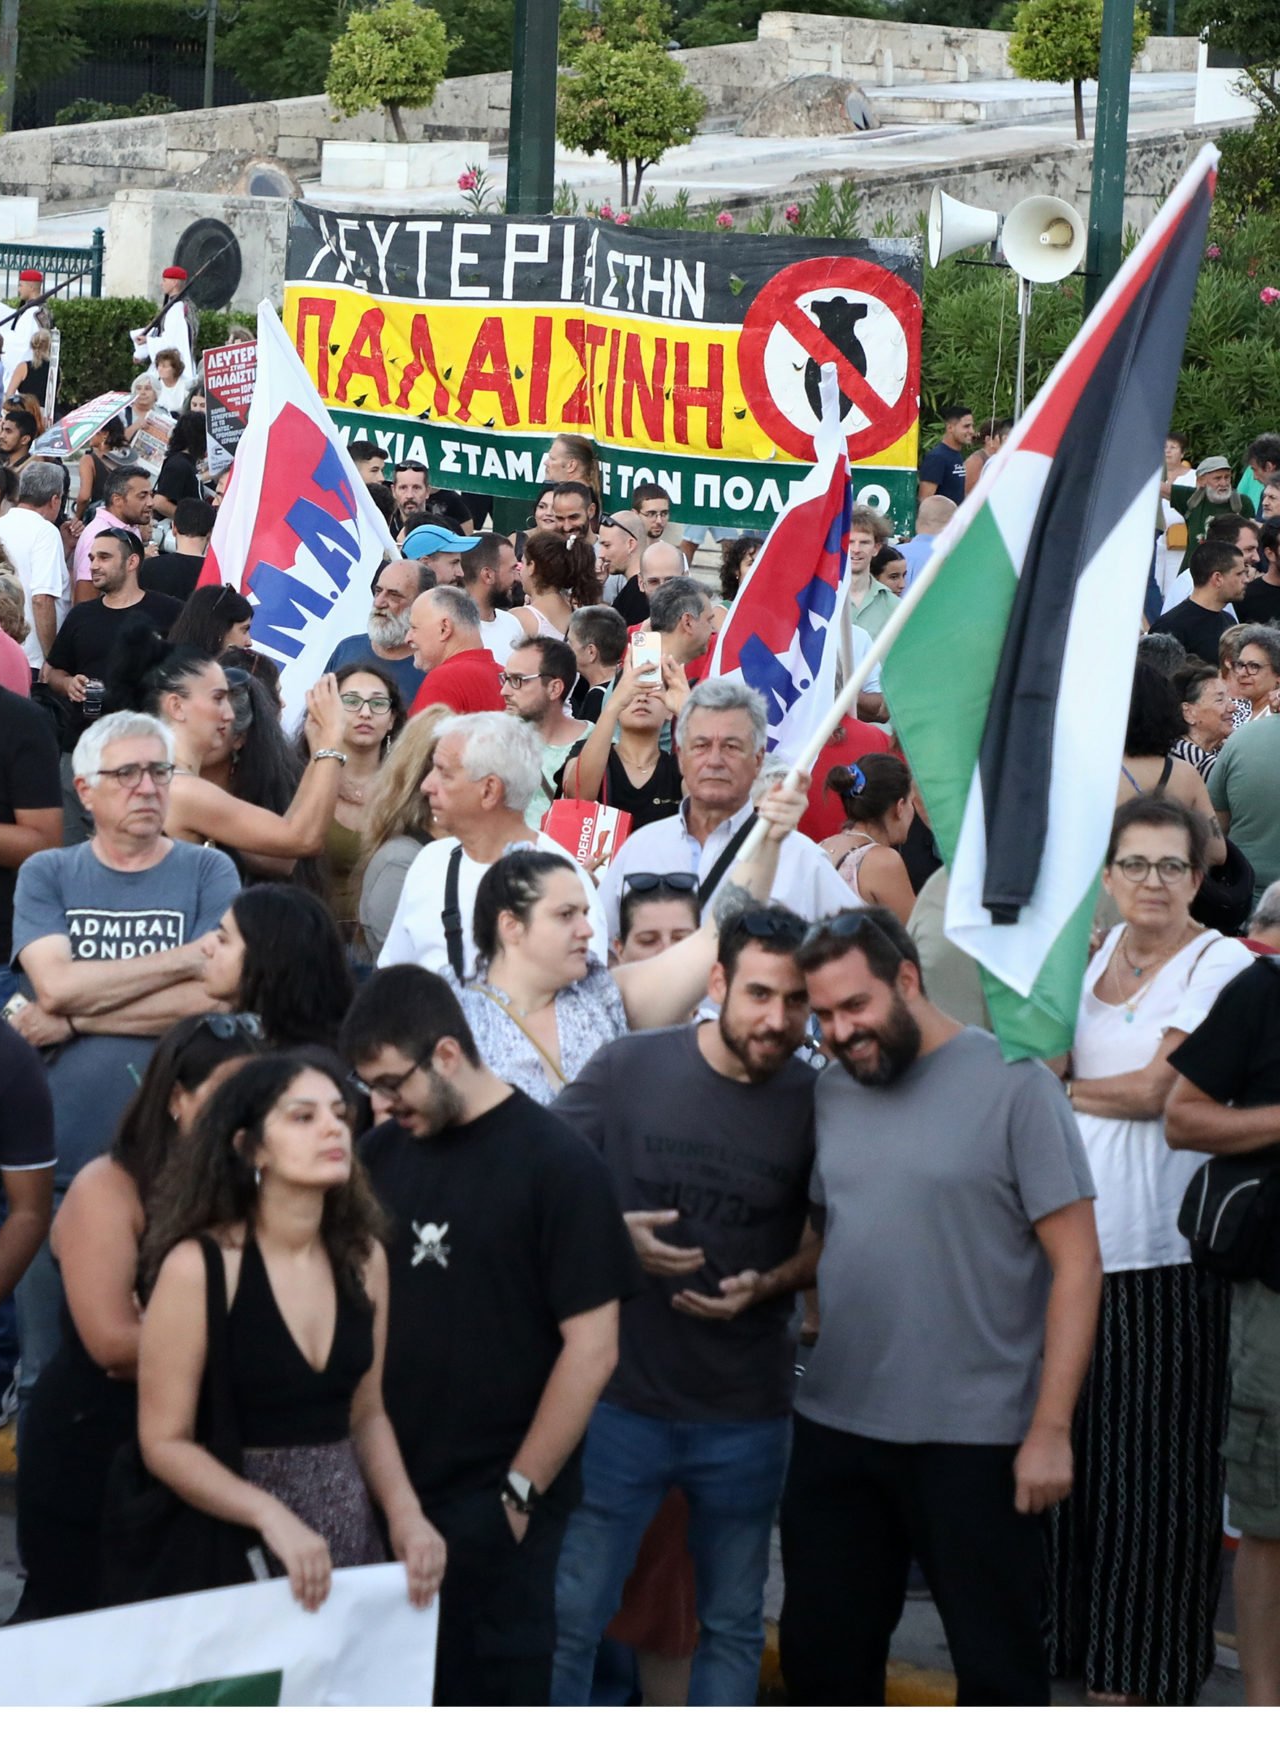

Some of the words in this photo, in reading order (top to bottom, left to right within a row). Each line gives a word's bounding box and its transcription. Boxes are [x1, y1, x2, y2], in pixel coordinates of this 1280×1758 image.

[601, 249, 705, 319] ΣΤΗΝ
[207, 346, 256, 369] ΛΕΥΤΕΡ
[208, 369, 256, 390] ΠΑΛΑΙΣΤΙ
[296, 297, 724, 449] ΠΑΛΑΙΣΤΙΝΗ
[694, 473, 891, 517] ΠΟΛΟ
[69, 918, 177, 938] ADMIRAL
[71, 939, 176, 960] ONDON
